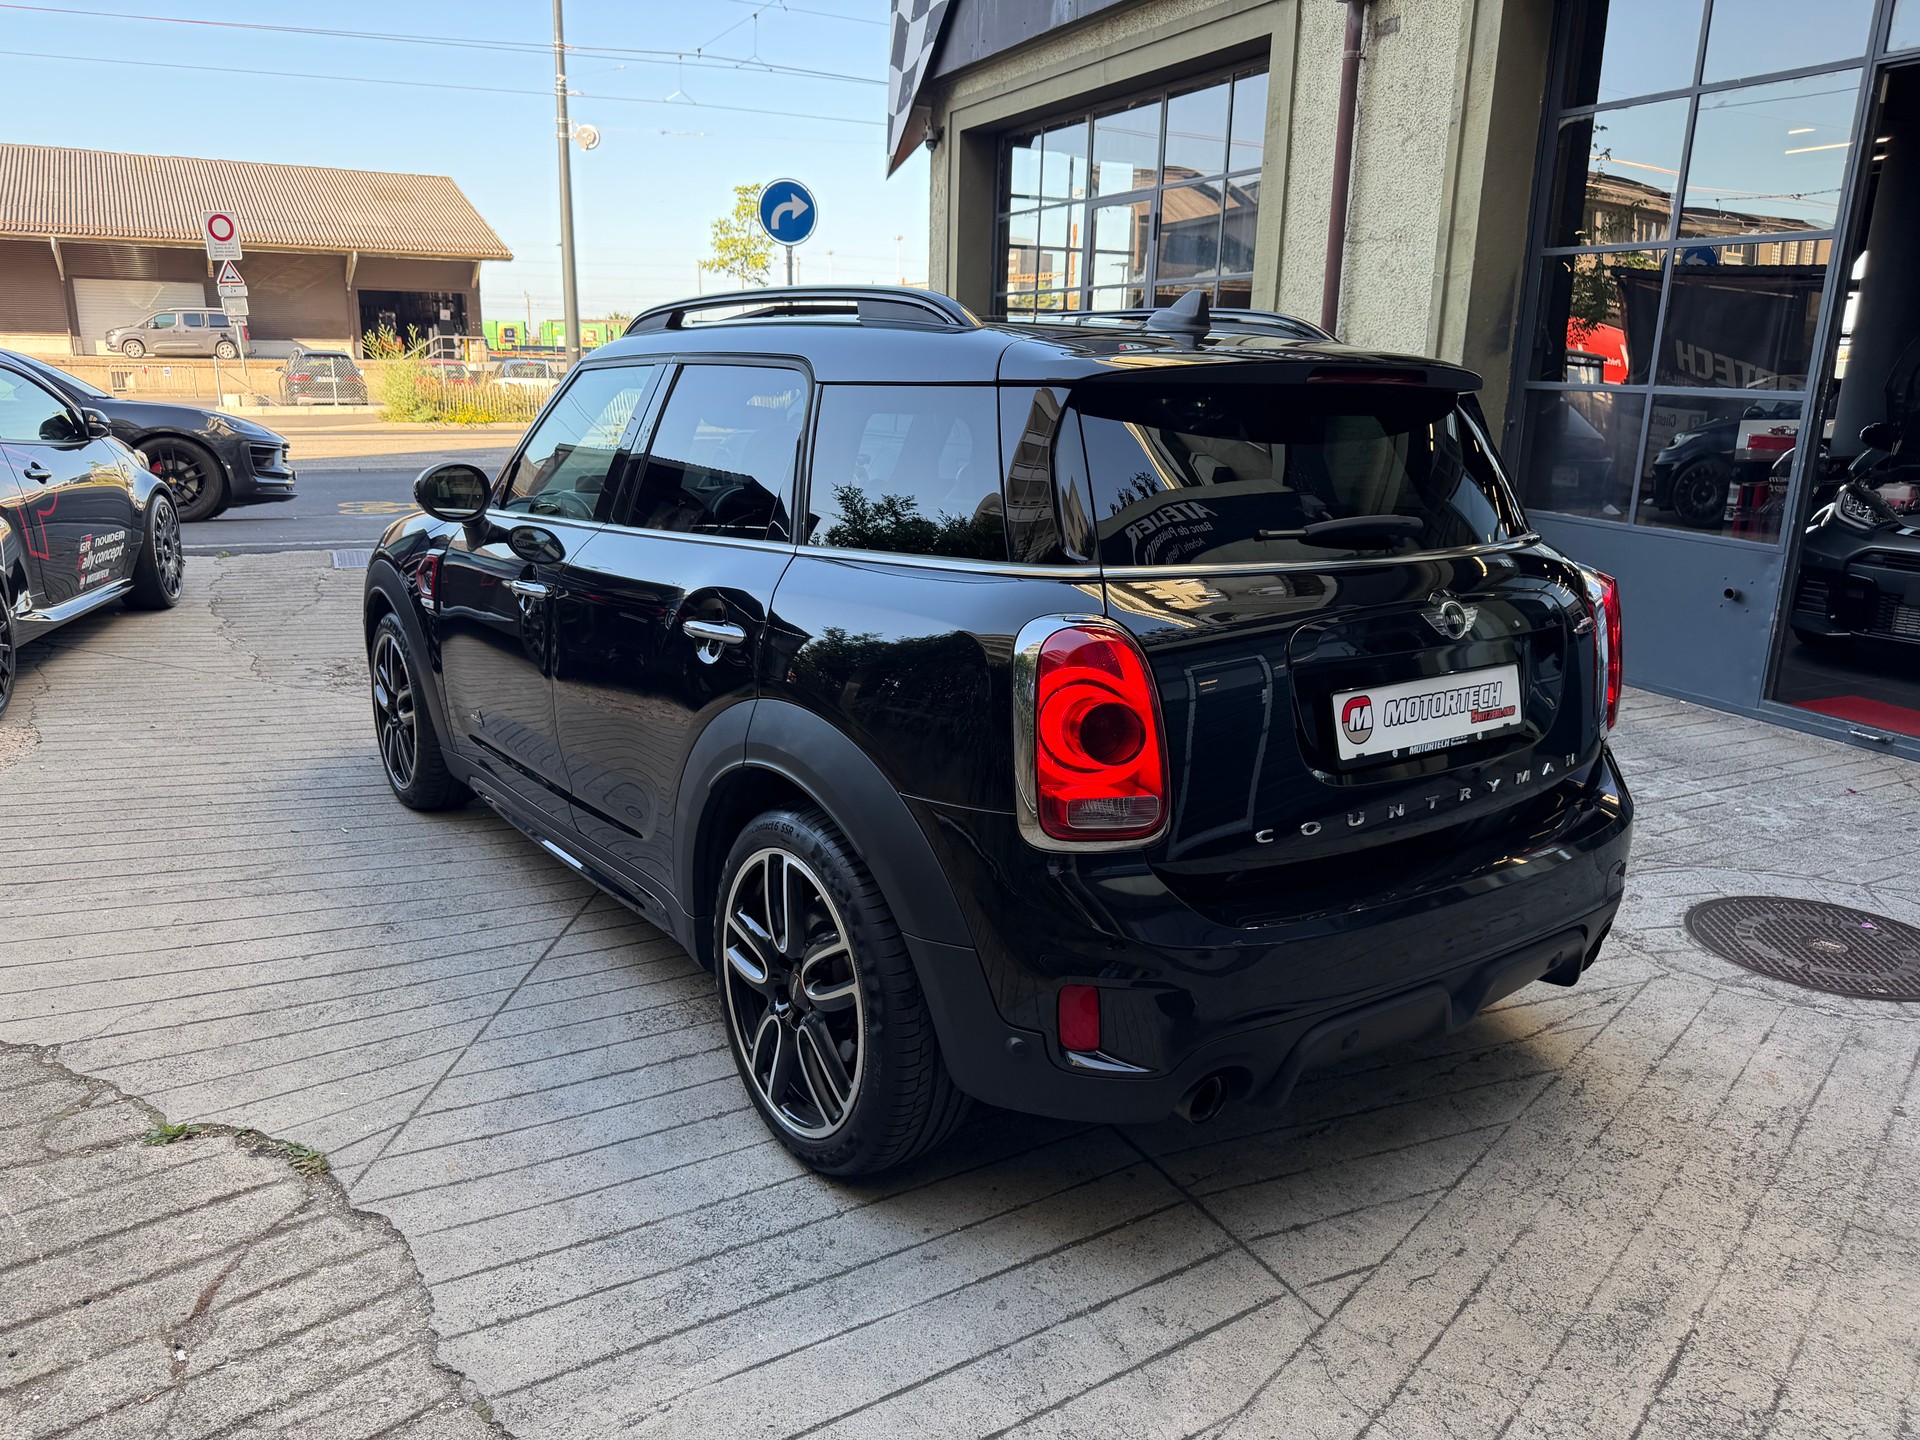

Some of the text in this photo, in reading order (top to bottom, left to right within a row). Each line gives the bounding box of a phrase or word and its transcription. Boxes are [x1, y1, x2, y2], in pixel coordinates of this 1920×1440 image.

[1445, 614, 1465, 626] MINI
[1383, 681, 1502, 728] MOTORTECH
[1408, 738, 1450, 756] MOTORTECH
[1255, 753, 1576, 845] COUNTRYMAN
